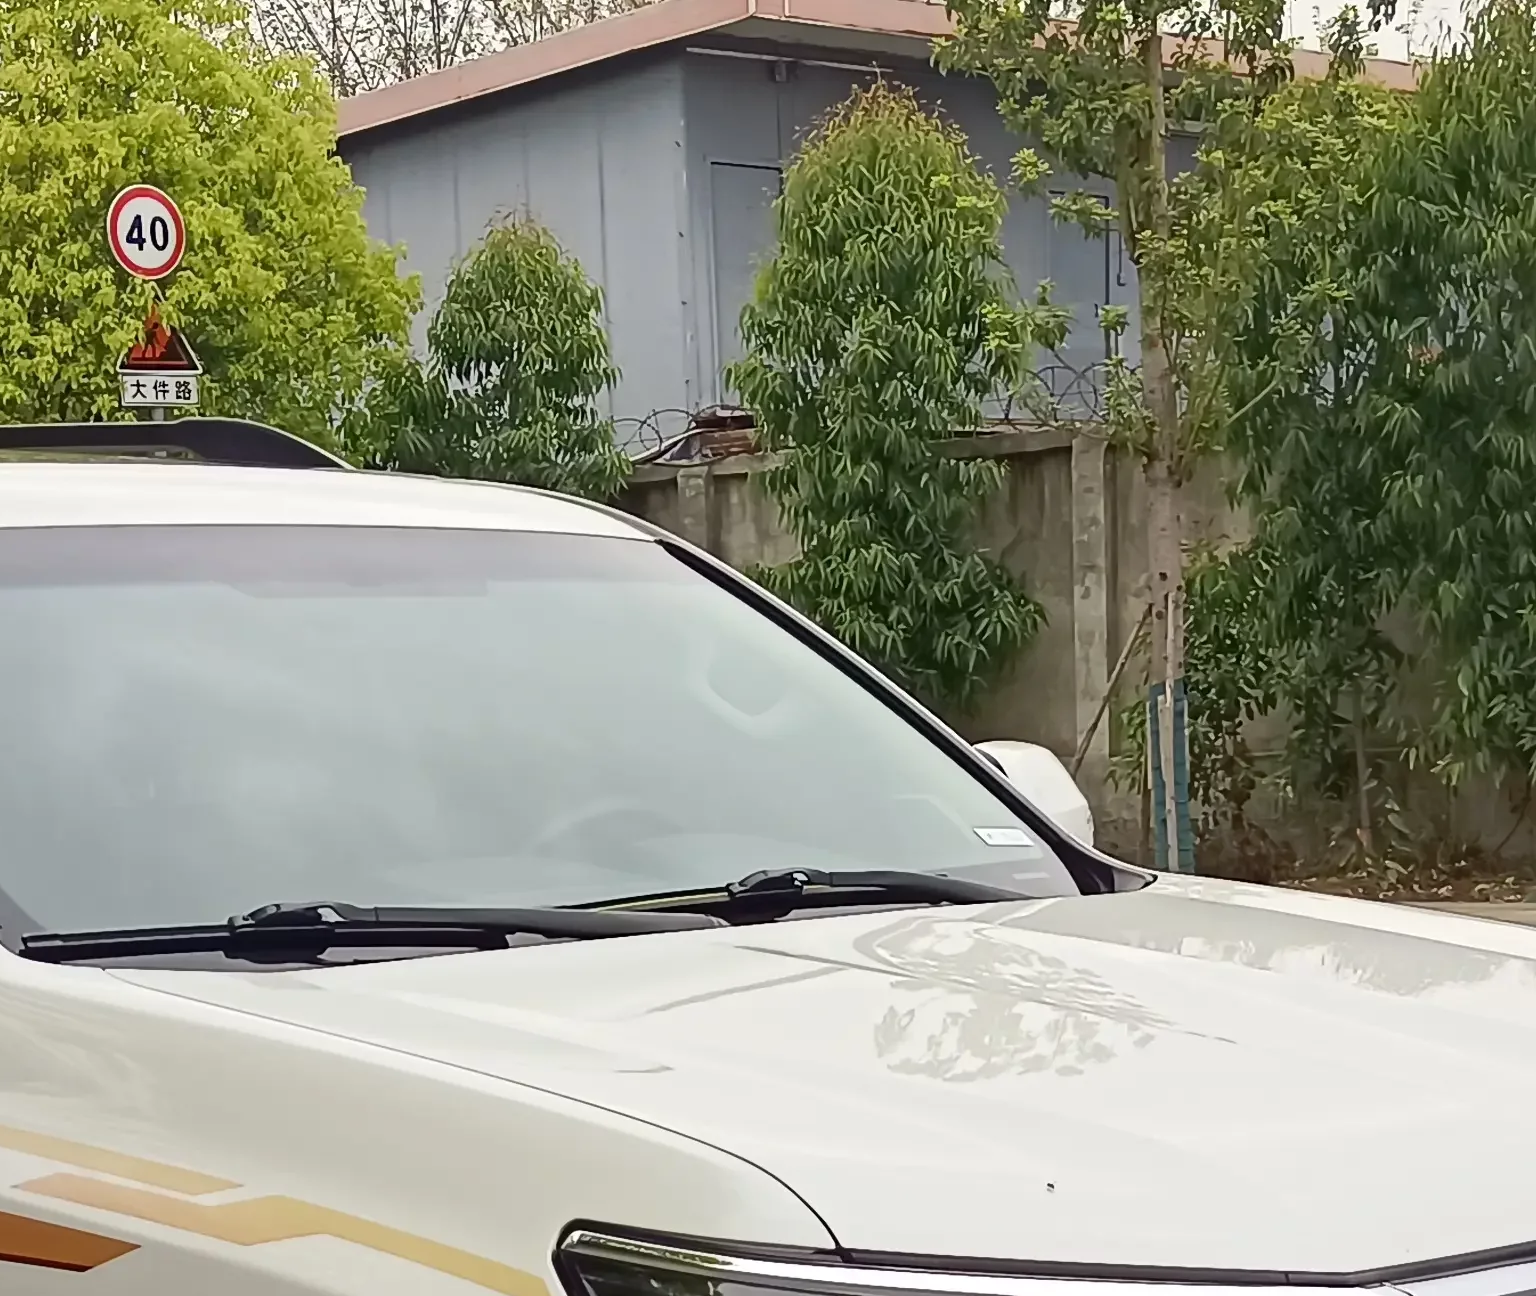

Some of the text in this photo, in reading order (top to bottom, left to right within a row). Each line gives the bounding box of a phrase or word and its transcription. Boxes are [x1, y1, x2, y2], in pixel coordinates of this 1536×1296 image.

[125, 214, 169, 251] 40
[129, 379, 192, 400] 大件路
